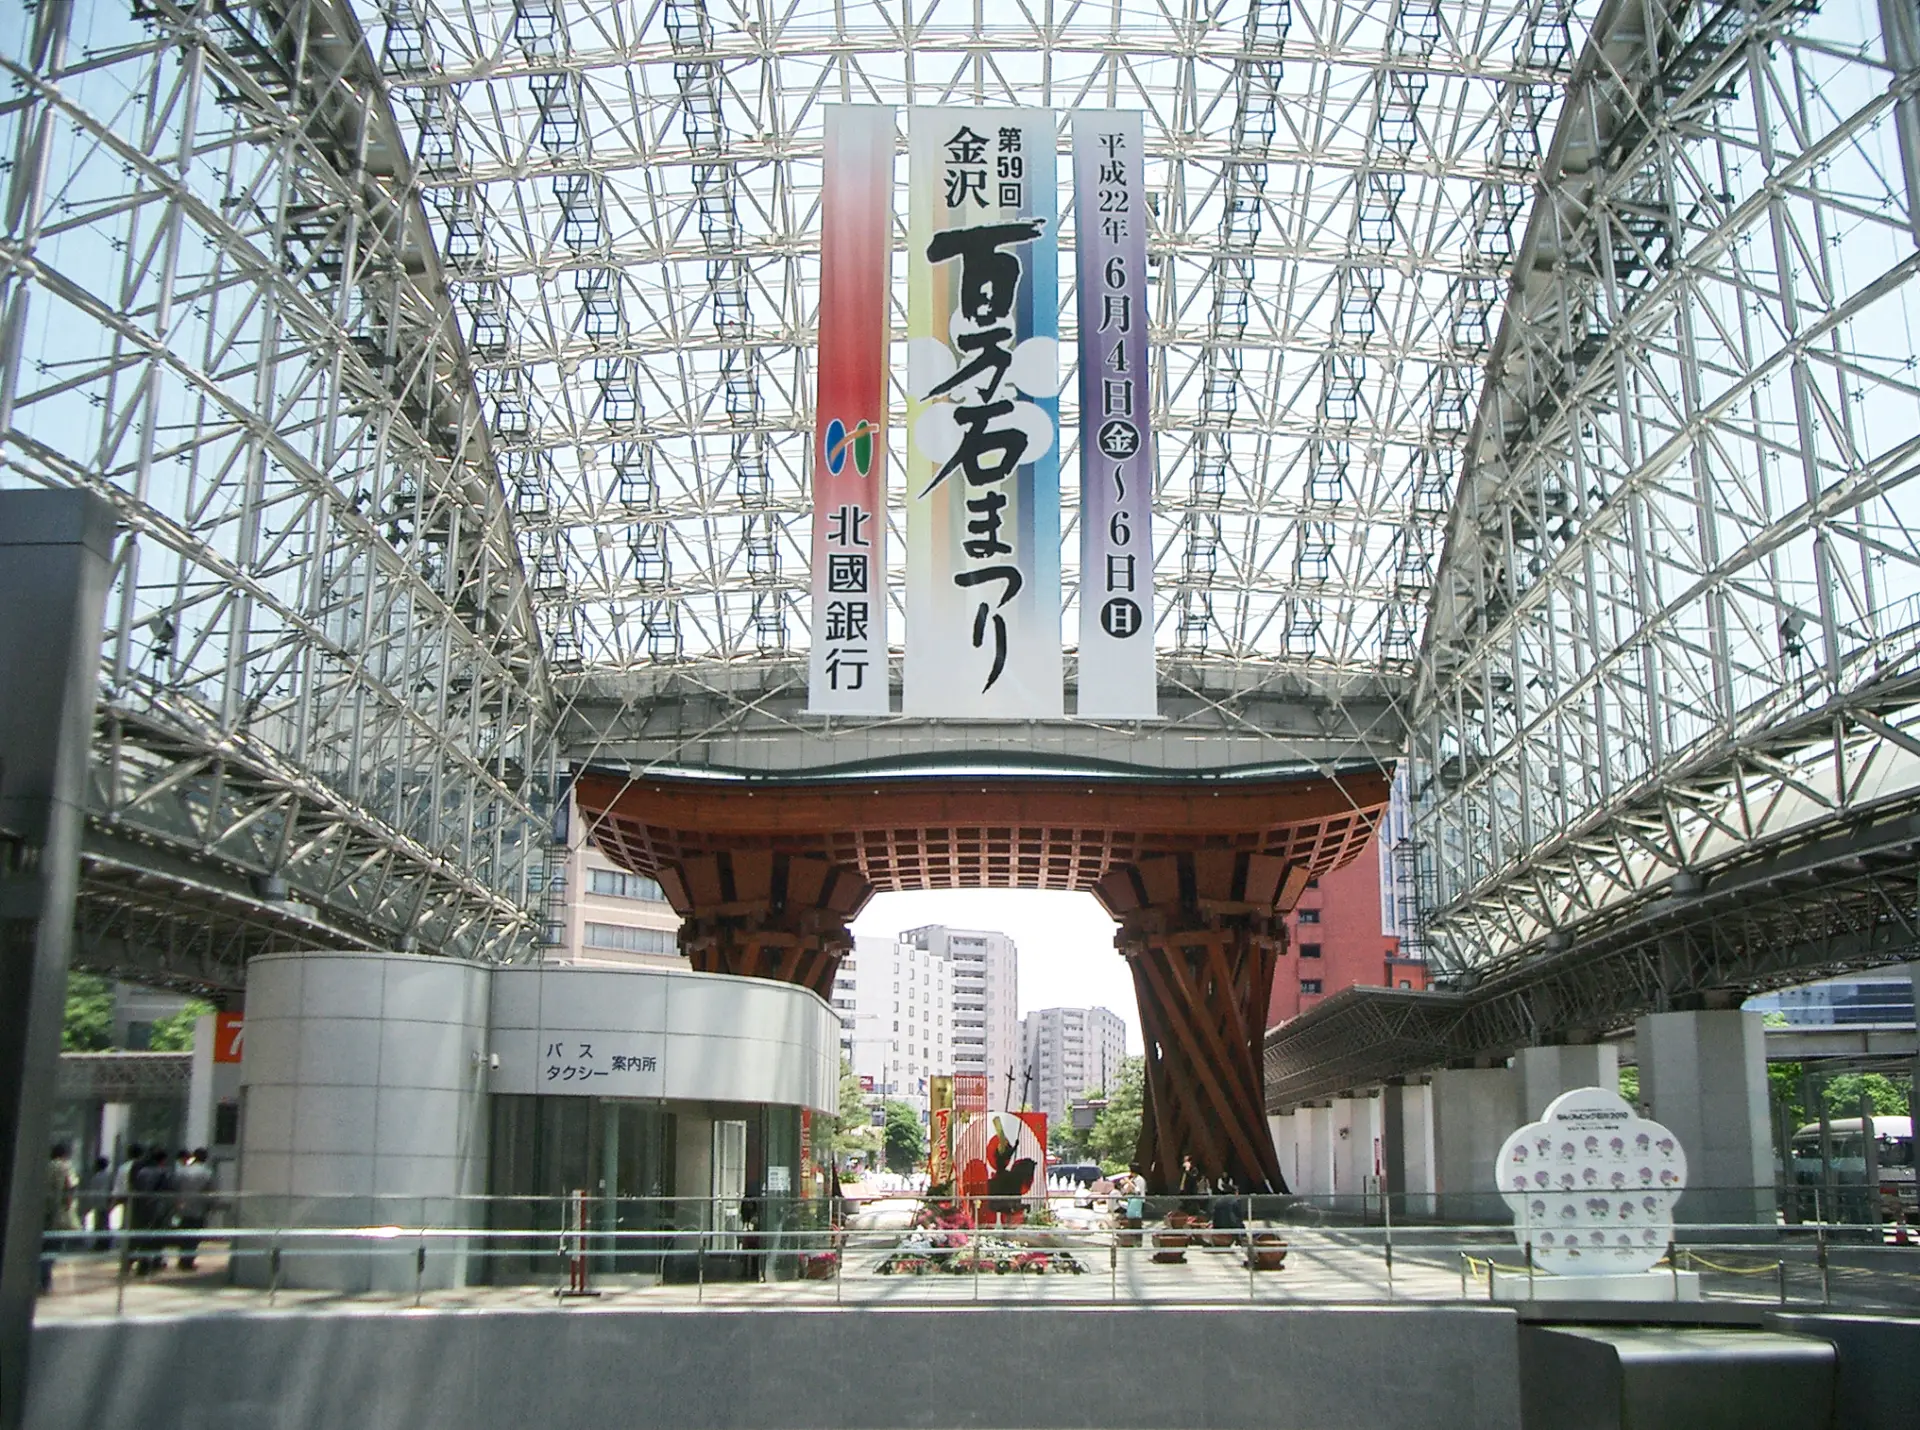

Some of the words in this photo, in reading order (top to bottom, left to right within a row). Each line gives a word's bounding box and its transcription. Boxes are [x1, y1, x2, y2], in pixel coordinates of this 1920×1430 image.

[943, 126, 990, 209] 金沢
[998, 127, 1023, 208] 第59回
[919, 219, 1046, 694] 百万石まつり
[825, 506, 870, 690] 北國銀行
[227, 1020, 244, 1056] 7
[546, 1065, 608, 1081] タクシー
[611, 1055, 656, 1072] 案内所
